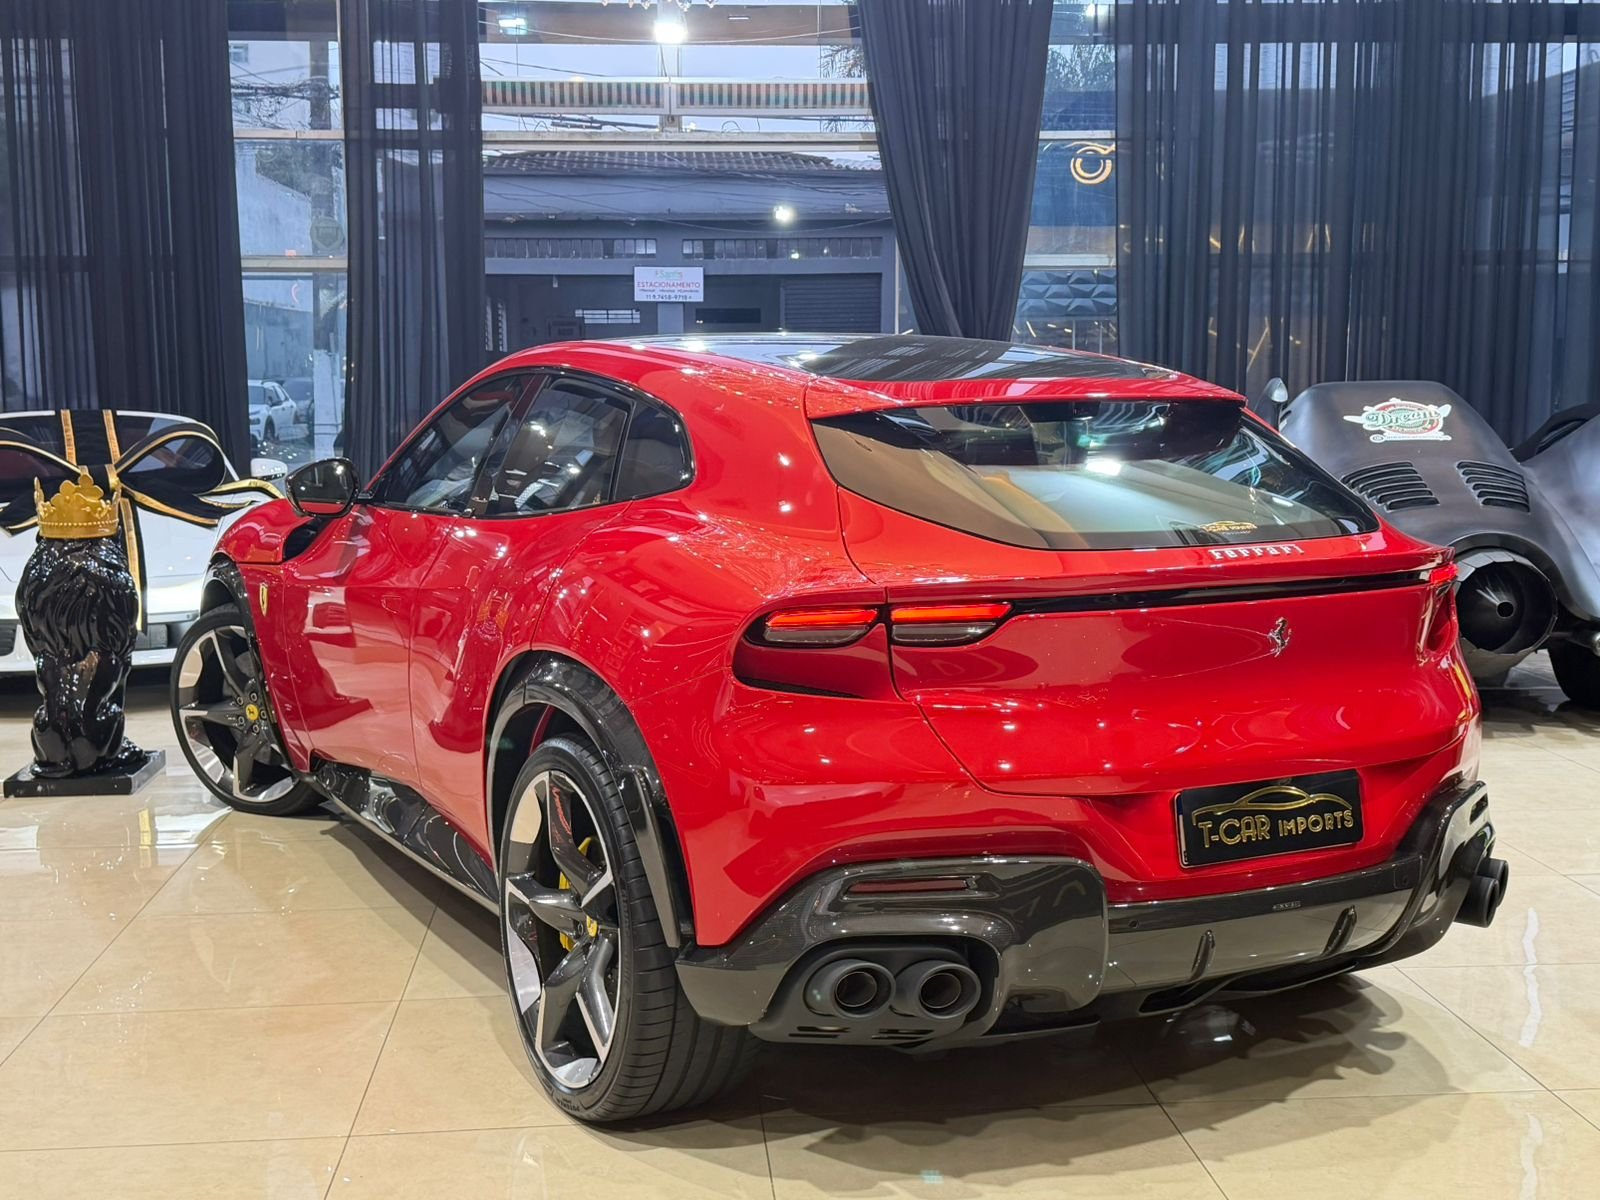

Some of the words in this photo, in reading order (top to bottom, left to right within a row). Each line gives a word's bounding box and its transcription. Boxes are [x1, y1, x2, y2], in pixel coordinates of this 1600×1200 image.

[636, 281, 700, 289] ESTACIONAMENTO
[1364, 408, 1440, 428] Dream
[1208, 543, 1305, 560] Ferrari
[1198, 814, 1271, 848] T-CAR
[1278, 809, 1355, 837] IMPORTS
